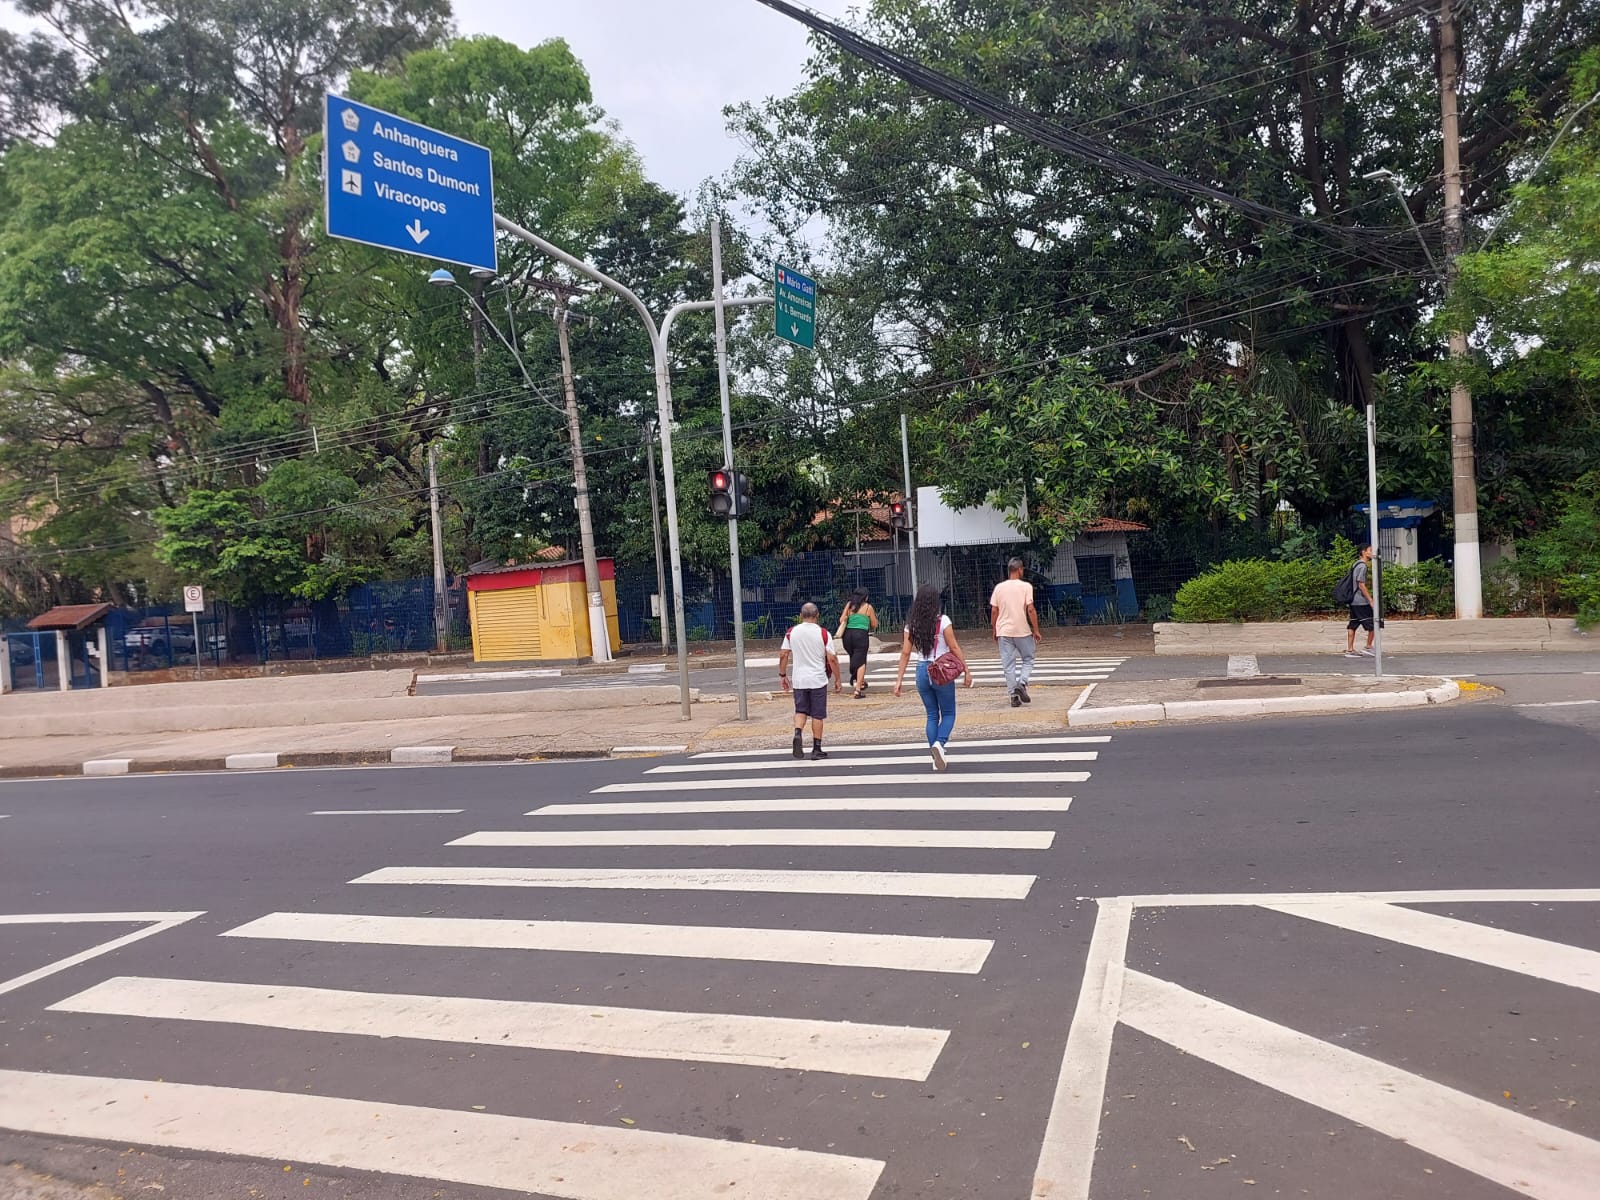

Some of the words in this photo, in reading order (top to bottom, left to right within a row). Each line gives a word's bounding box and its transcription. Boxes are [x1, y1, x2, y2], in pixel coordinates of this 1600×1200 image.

[373, 121, 458, 162] Anhanguera
[373, 151, 423, 179] Santos
[427, 167, 480, 196] Dumont
[374, 181, 447, 214] Viracopos
[191, 590, 197, 598] E
